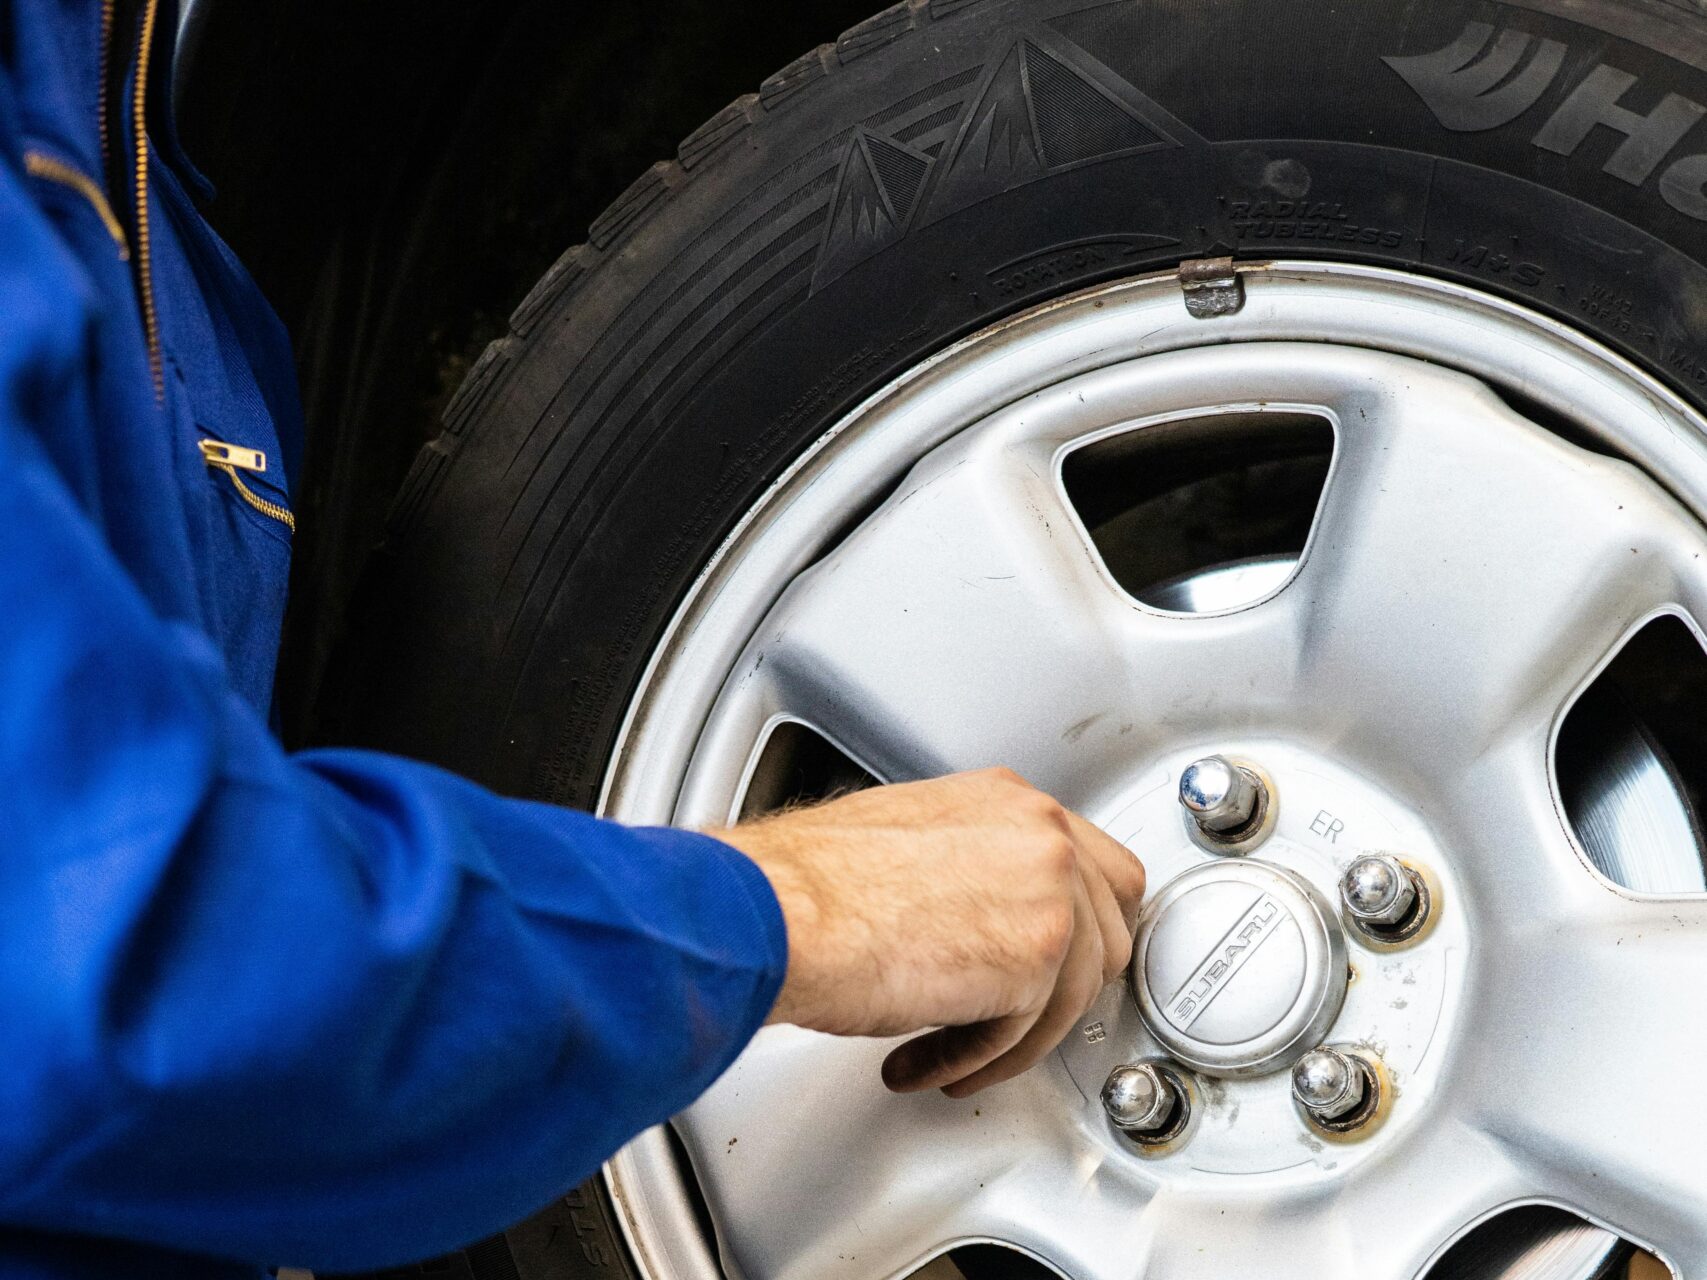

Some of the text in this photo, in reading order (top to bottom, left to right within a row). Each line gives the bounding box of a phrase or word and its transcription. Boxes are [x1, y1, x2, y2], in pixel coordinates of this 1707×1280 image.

[1229, 201, 1347, 221] RADIAL
[1233, 222, 1404, 249] TUBELESS
[1308, 808, 1345, 845] ER
[1173, 900, 1279, 1022] SUBARU
